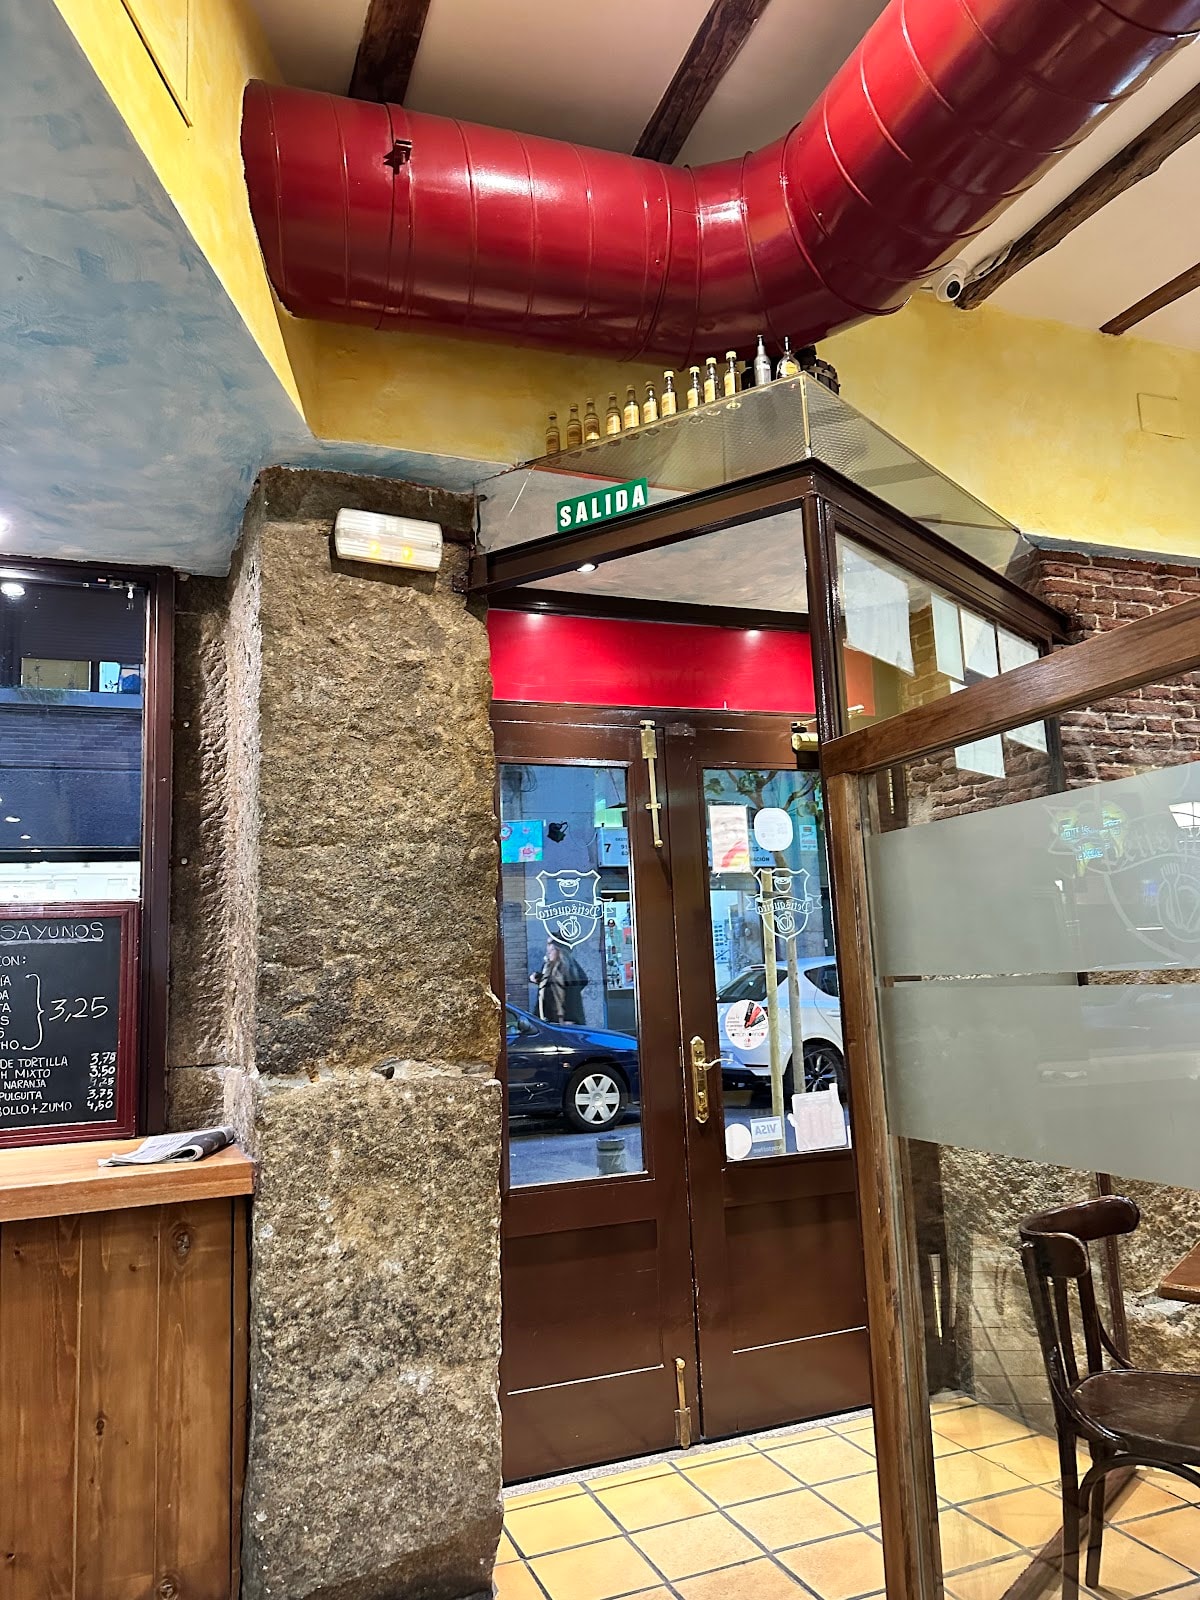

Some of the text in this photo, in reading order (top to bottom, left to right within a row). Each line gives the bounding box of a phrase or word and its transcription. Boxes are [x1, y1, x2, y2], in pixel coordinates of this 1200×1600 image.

[560, 484, 646, 528] SALIDA
[49, 997, 109, 1022] 3,25
[0, 1058, 14, 1070] DE
[18, 1055, 68, 1068] TORTILLA
[15, 1068, 51, 1079] MIXTO
[89, 1065, 116, 1078] 3,50
[3, 1079, 47, 1090] NARANJA
[0, 1088, 114, 1101] PULGUITA 3,75
[86, 1100, 114, 1112] 4,50
